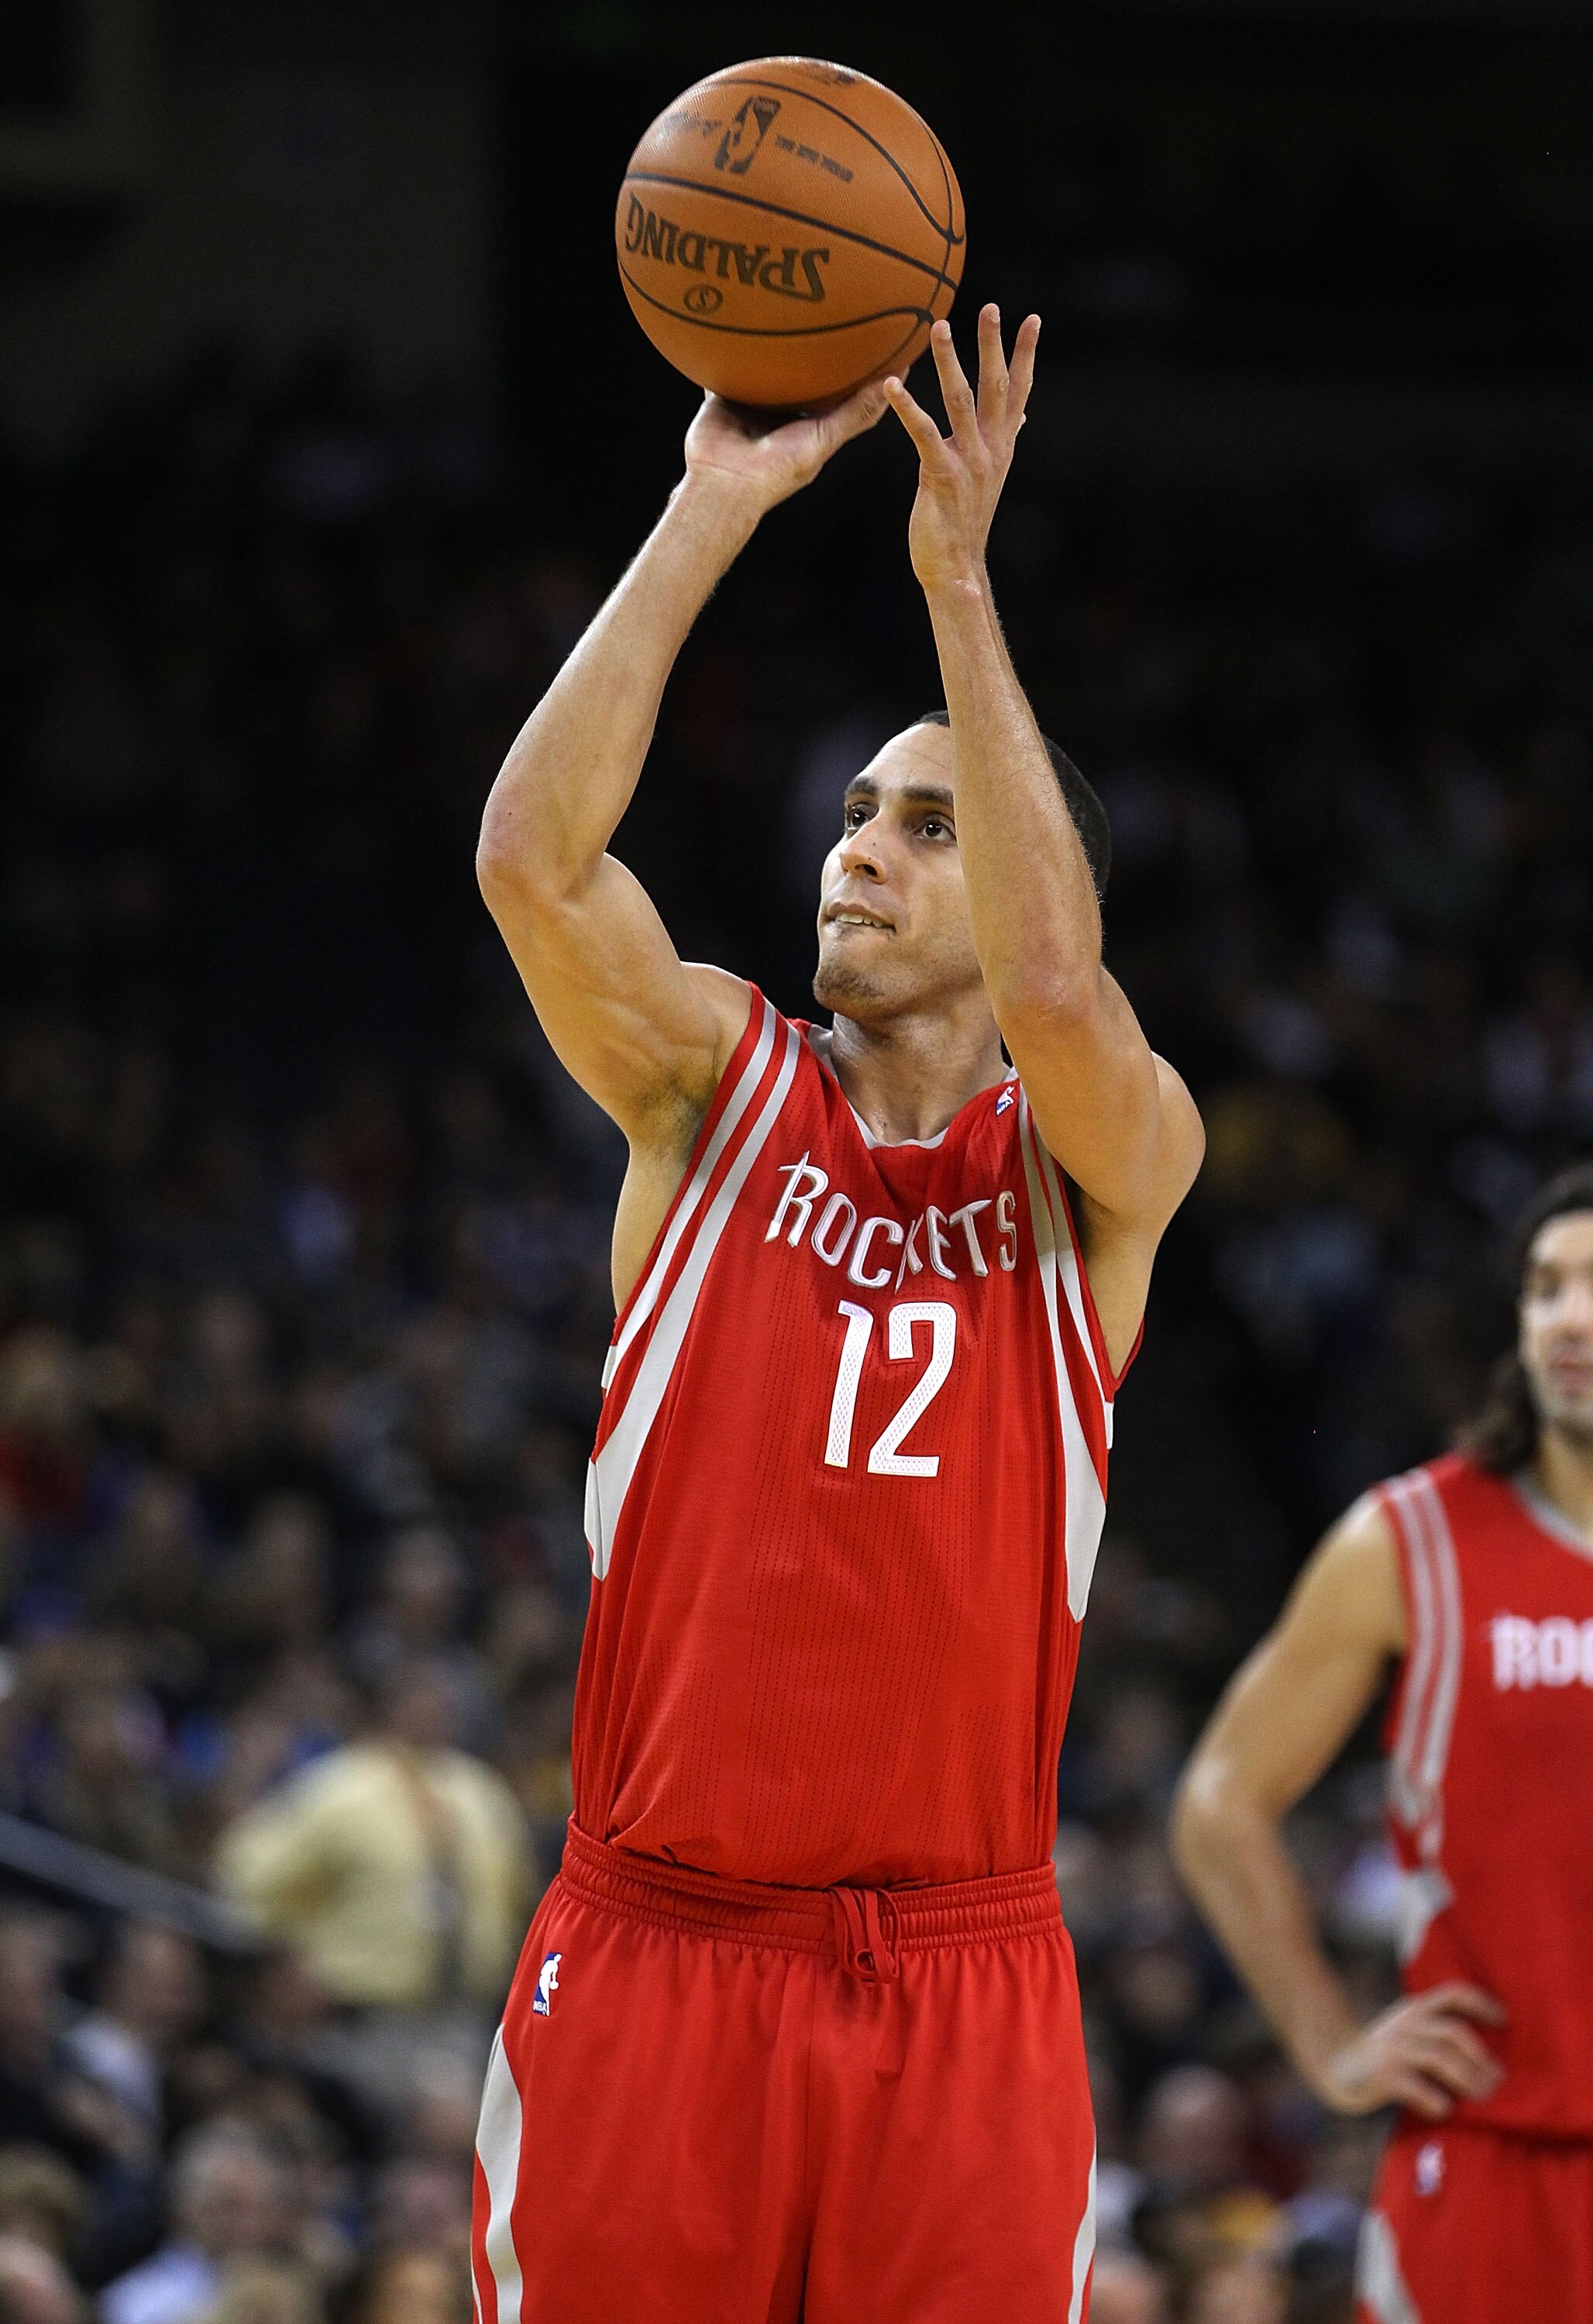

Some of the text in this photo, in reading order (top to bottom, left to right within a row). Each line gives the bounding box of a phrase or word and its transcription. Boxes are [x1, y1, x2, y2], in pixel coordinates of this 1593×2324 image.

[625, 192, 830, 303] SPALDING
[764, 1150, 1017, 1294] ROCKETS
[824, 1300, 958, 1477] 12
[533, 2000, 547, 2015] NBA
